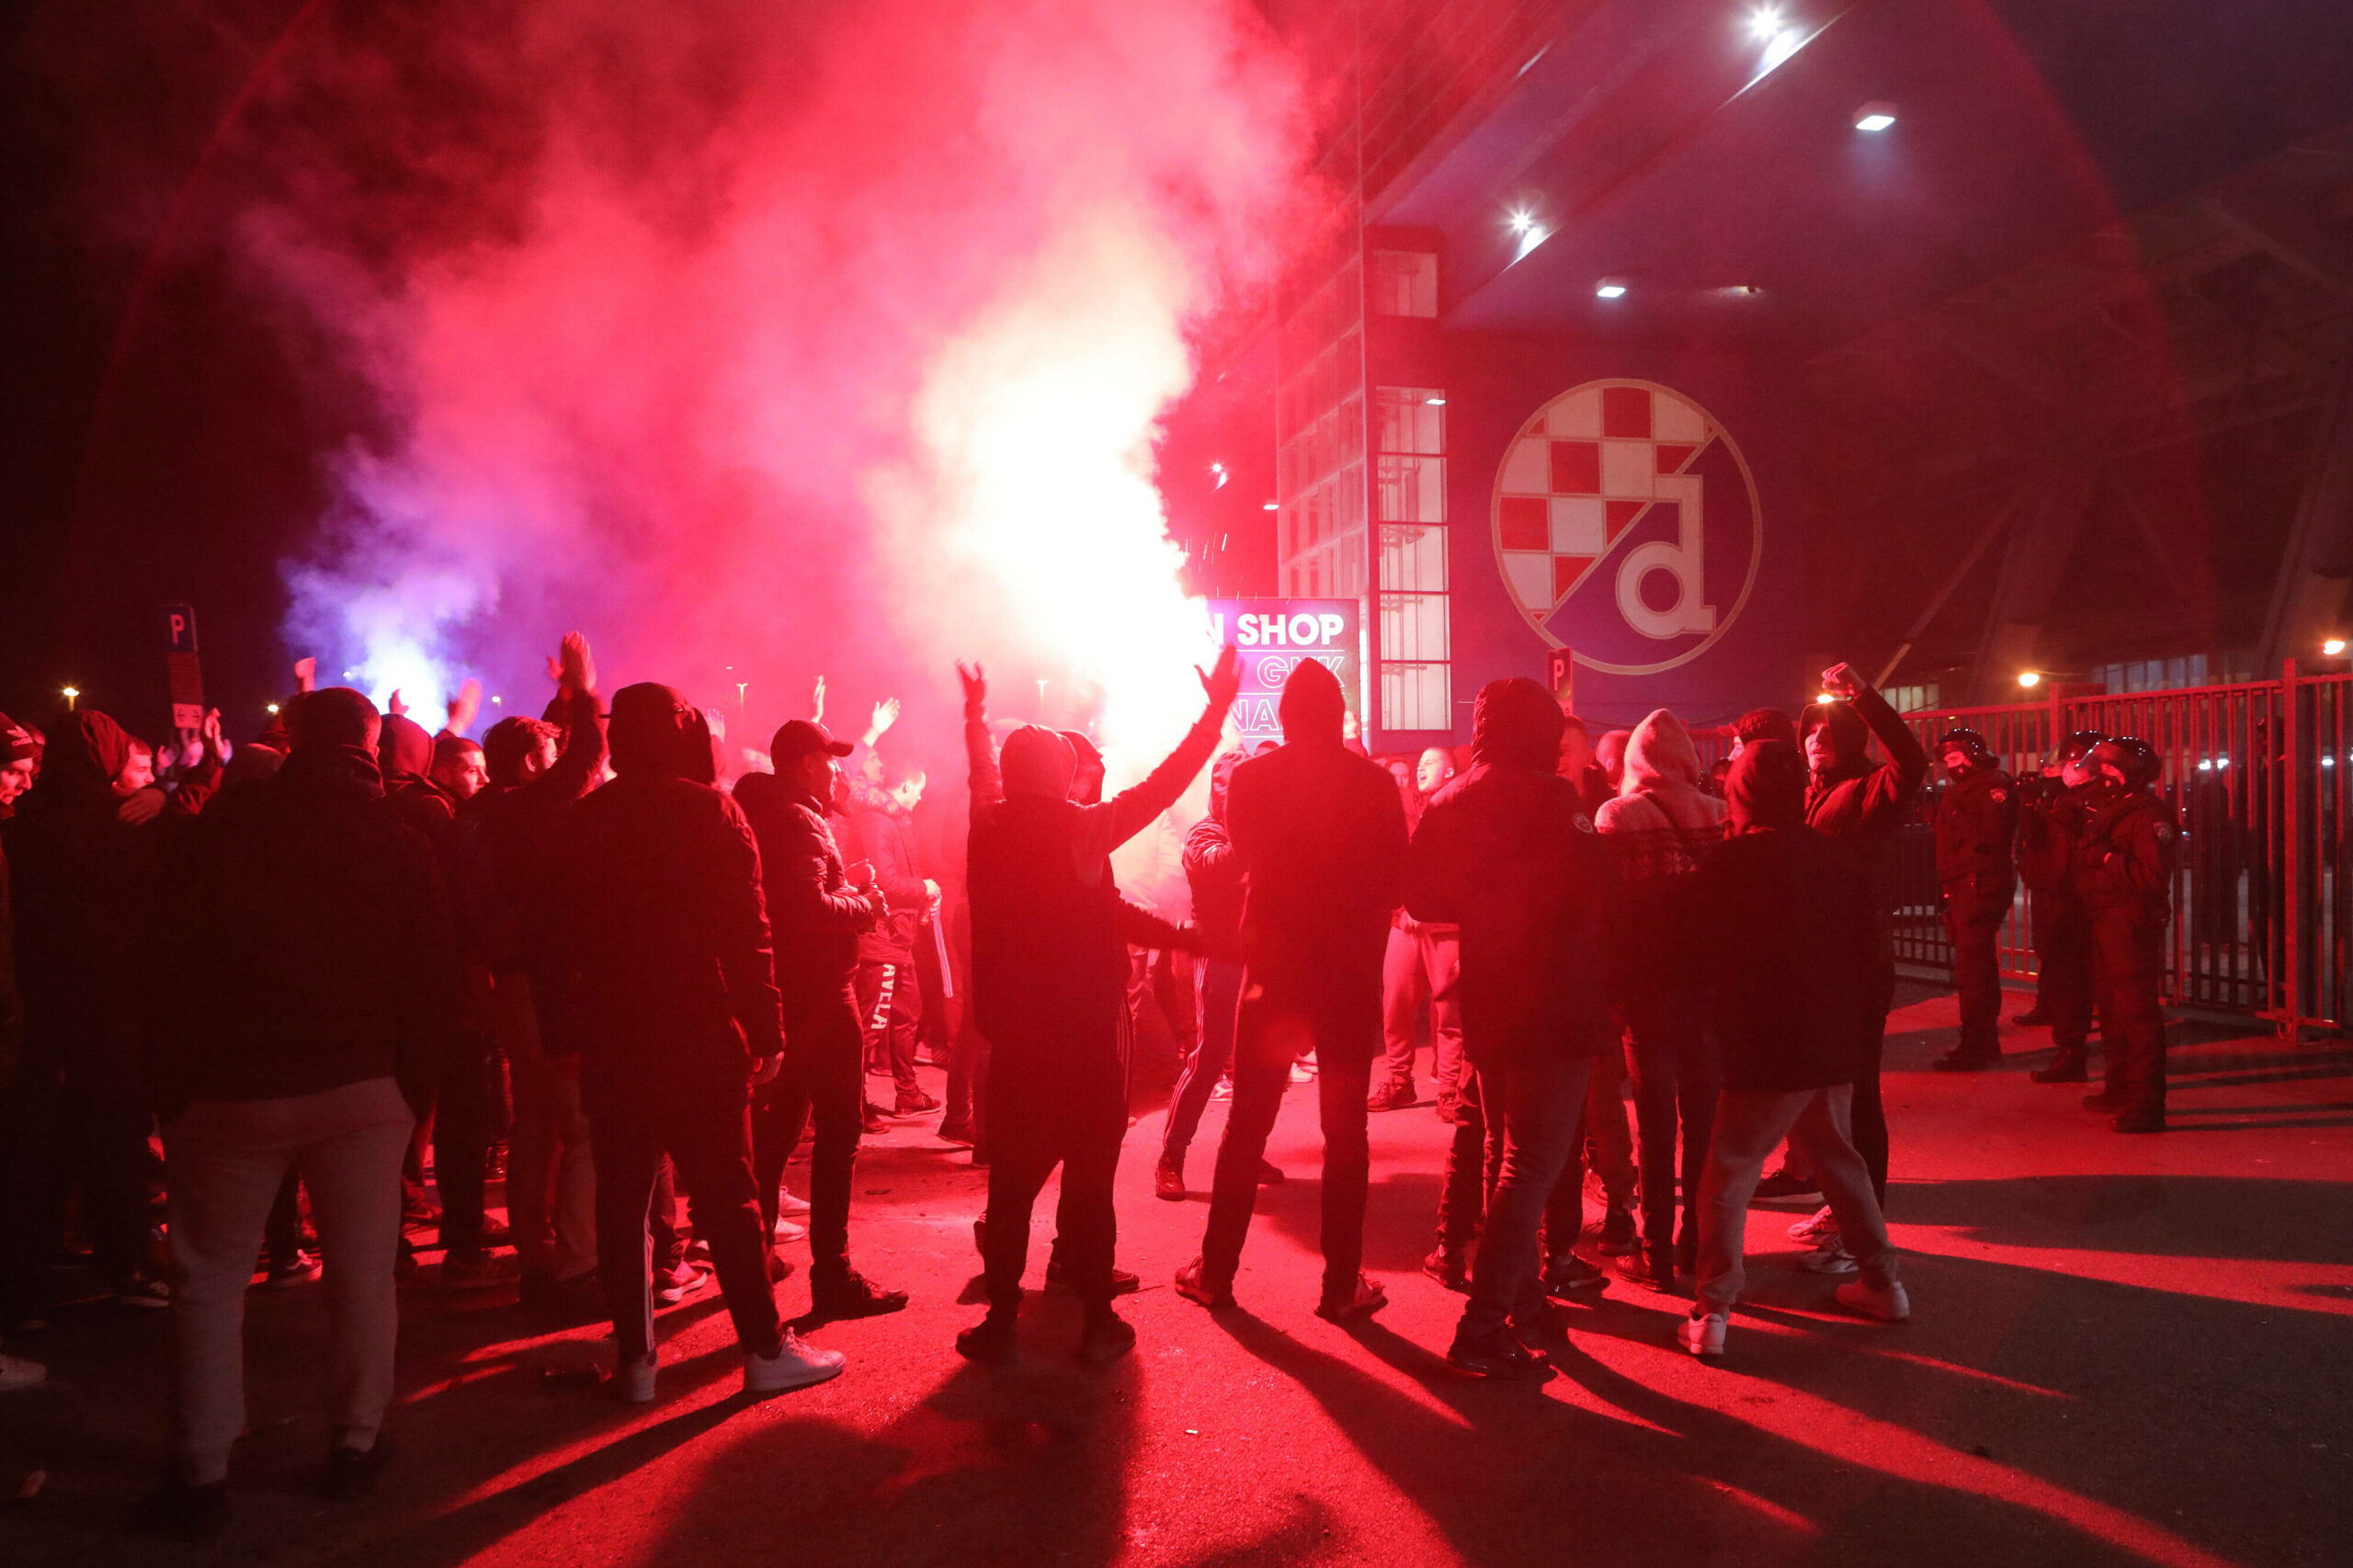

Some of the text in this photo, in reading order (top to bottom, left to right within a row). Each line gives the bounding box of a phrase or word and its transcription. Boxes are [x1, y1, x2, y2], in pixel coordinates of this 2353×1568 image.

[170, 617, 186, 644] P
[1237, 613, 1345, 645] SHOP
[1257, 655, 1346, 688] GK
[1553, 659, 1564, 691] P
